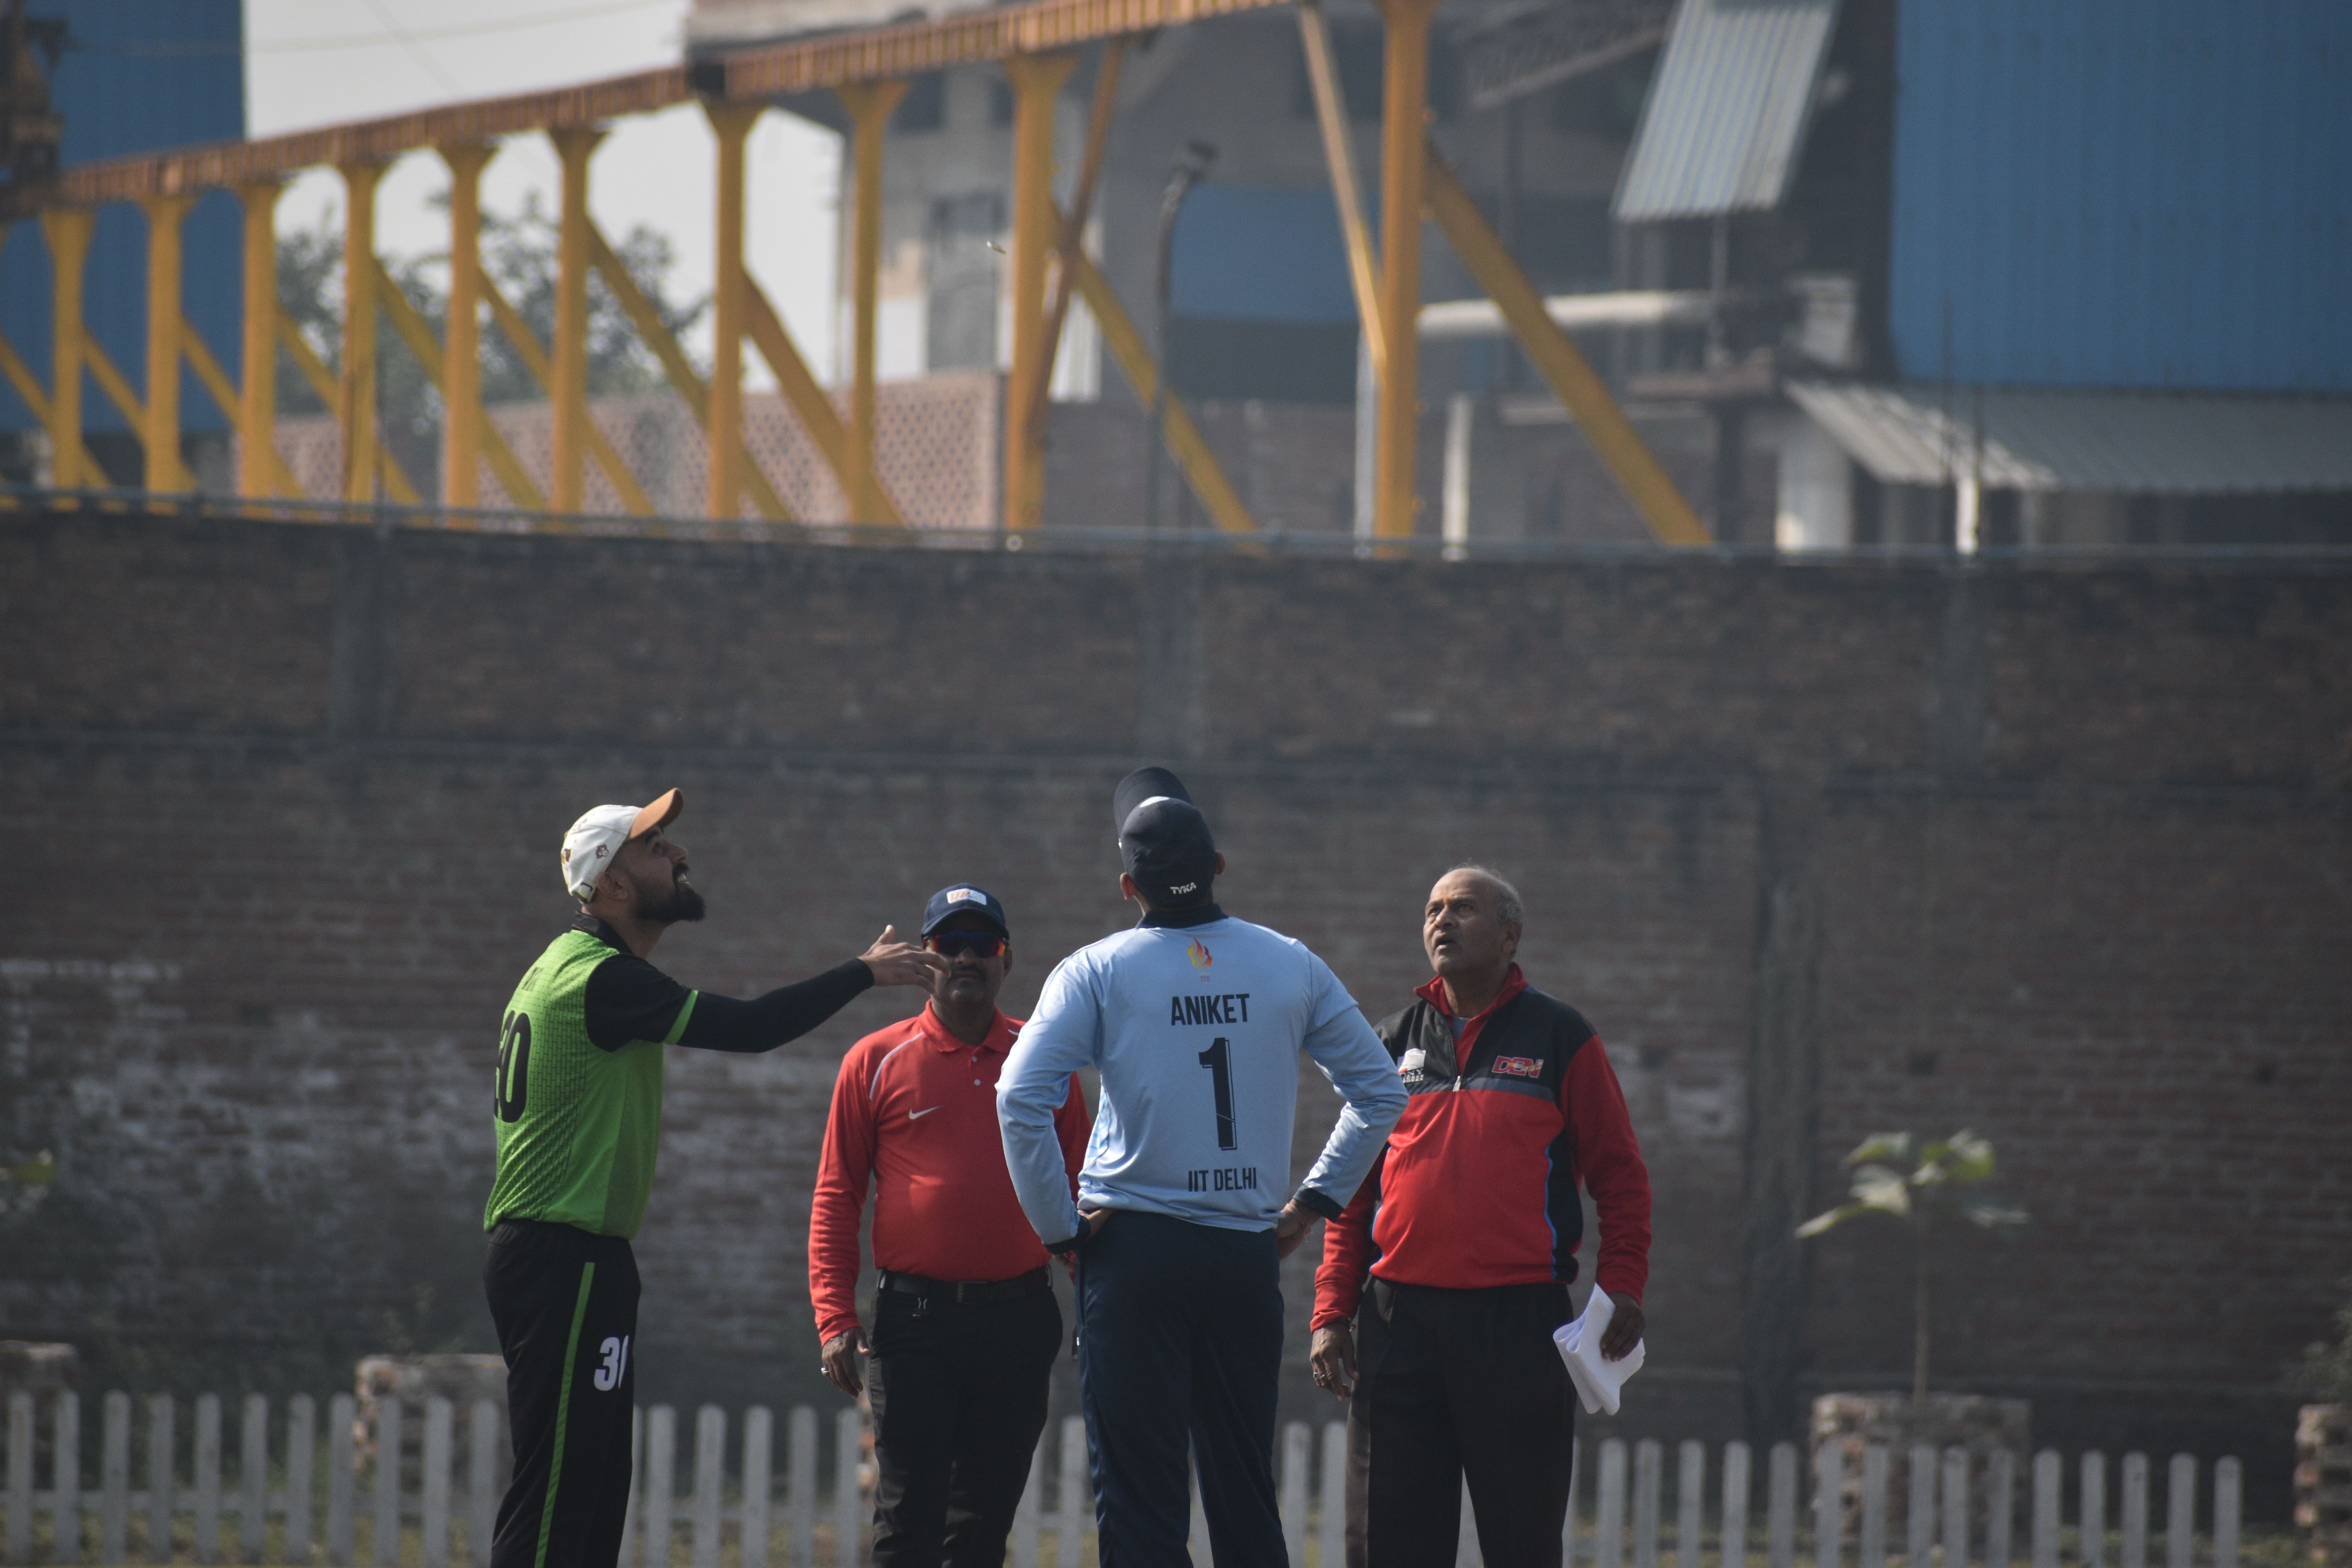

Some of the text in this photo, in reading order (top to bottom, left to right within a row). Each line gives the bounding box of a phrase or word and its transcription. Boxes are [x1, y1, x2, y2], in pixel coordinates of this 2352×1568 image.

[1170, 882, 1196, 894] TYKA
[1171, 993, 1250, 1025] ANIKET
[1399, 1068, 1424, 1078] ONY
[1491, 1055, 1544, 1078] DEN
[1198, 1037, 1237, 1151] 1
[1188, 1167, 1257, 1192] IIT DELHI
